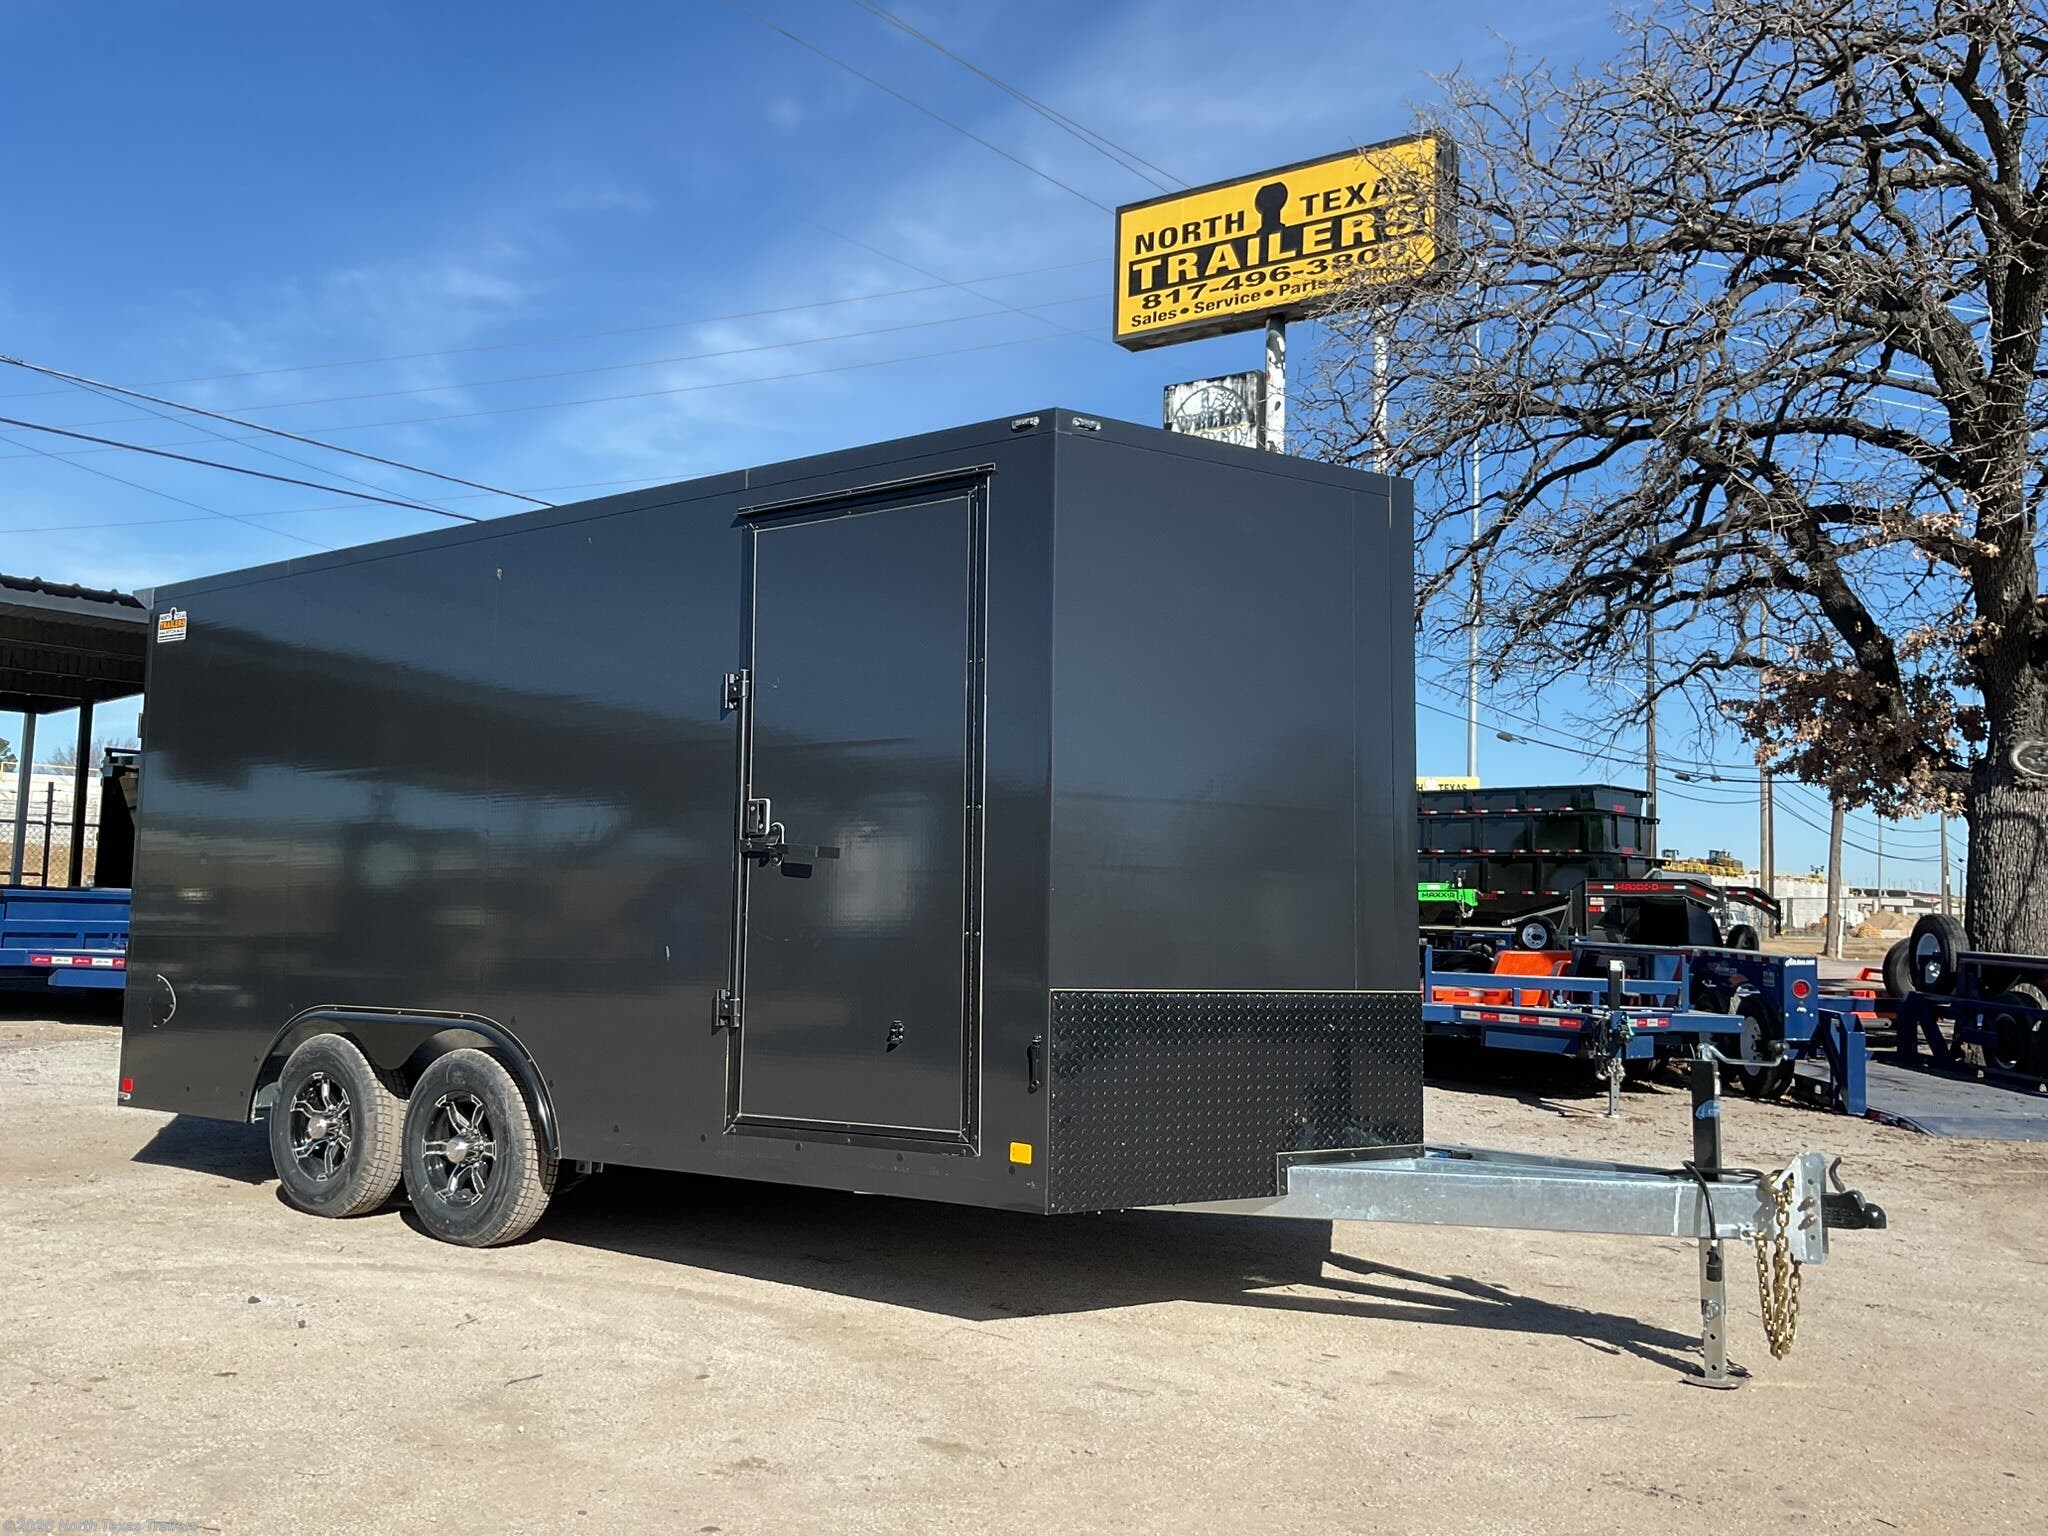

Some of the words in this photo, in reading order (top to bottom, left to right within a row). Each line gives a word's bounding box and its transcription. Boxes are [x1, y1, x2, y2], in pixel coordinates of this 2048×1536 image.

[1131, 203, 1420, 291] TRAILERS
[1135, 210, 1245, 255] NORTH
[1131, 307, 1177, 328] Sales
[1193, 291, 1261, 314] Service
[1279, 278, 1328, 296] Parts
